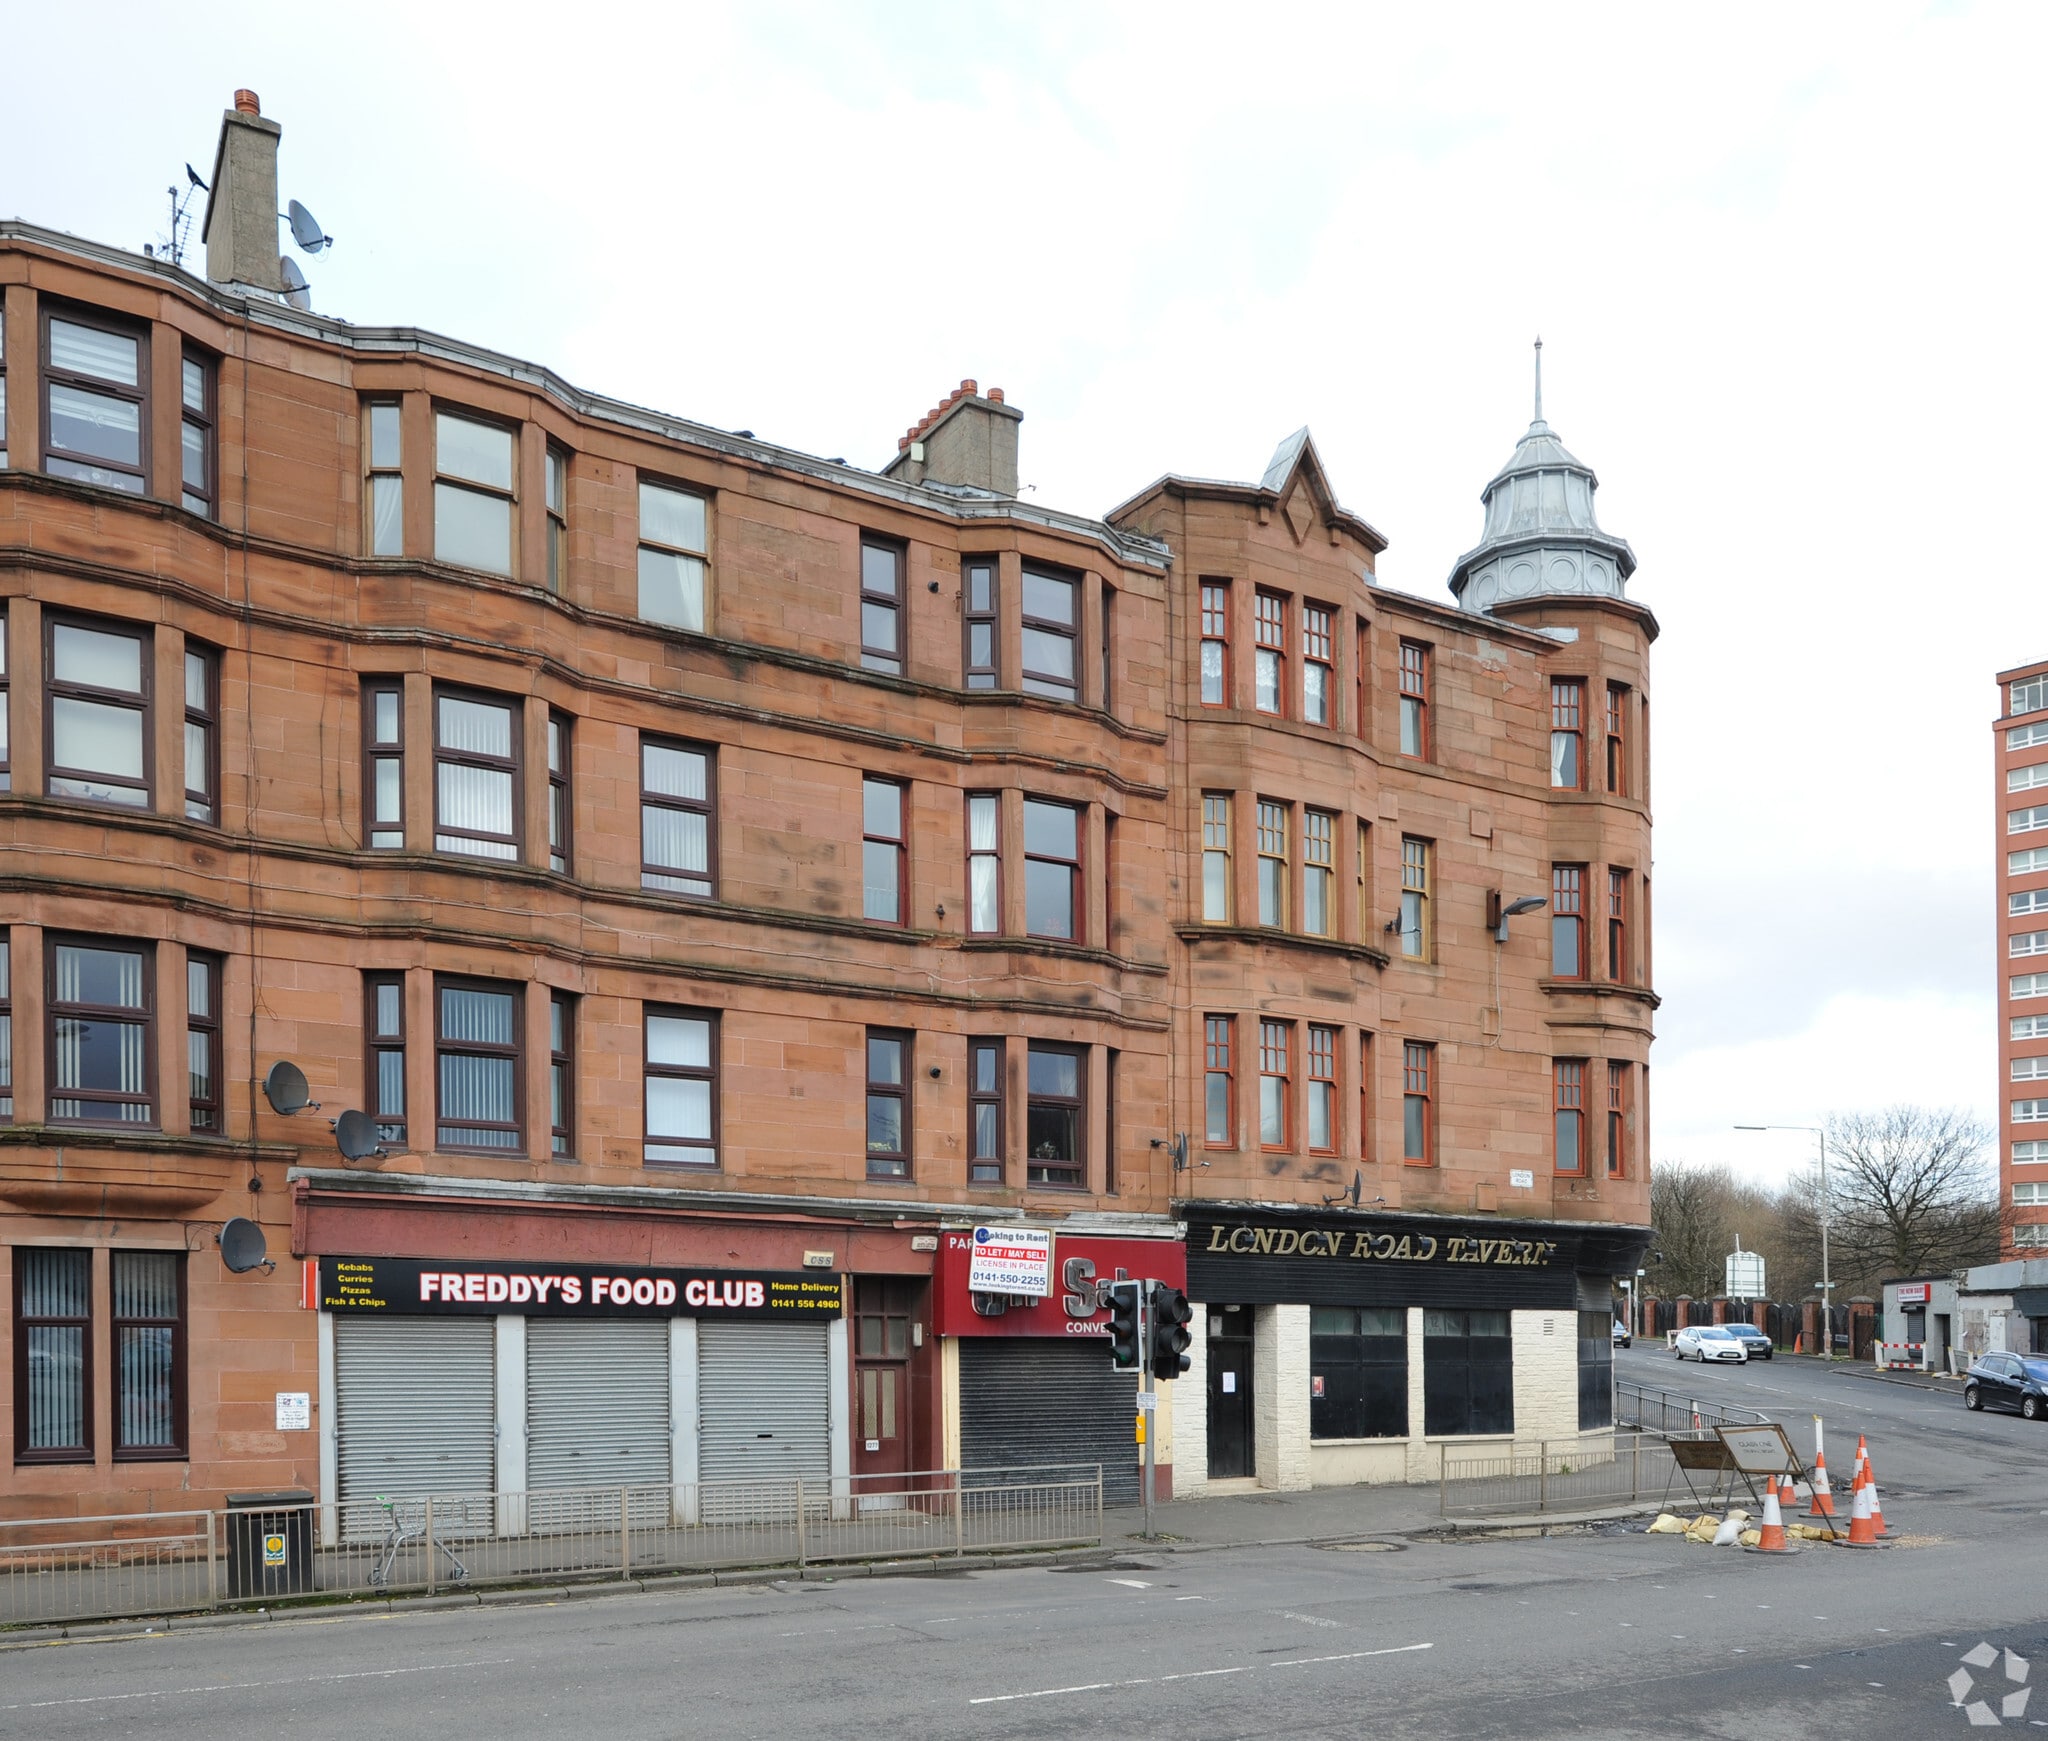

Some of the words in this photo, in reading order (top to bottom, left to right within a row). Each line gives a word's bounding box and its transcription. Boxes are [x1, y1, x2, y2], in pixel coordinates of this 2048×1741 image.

[979, 1231, 1014, 1242] Looking
[1015, 1233, 1025, 1241] to
[1026, 1233, 1048, 1242] Rent
[1206, 1225, 1345, 1257] LONDON
[1350, 1232, 1438, 1260] ROAD
[976, 1247, 986, 1256] TO
[987, 1248, 1003, 1257] LET
[1008, 1249, 1025, 1259] MAY
[1026, 1250, 1046, 1260] SELL
[337, 1263, 374, 1272] Kebabs
[976, 1260, 1008, 1269] LICENSE
[1019, 1262, 1044, 1271] PLACE
[337, 1274, 374, 1283] Curries
[340, 1286, 371, 1295] Pizzas
[420, 1273, 582, 1304] FREDDY'S
[591, 1277, 677, 1306] FOOD
[685, 1279, 765, 1308] CLUB
[771, 1282, 799, 1291] Home
[801, 1283, 839, 1294] Delivery
[325, 1298, 346, 1306] Fish
[348, 1298, 357, 1306] &
[358, 1298, 386, 1308] Chips
[771, 1299, 795, 1308] 0141
[797, 1299, 815, 1309] 556
[816, 1300, 840, 1309] 4960
